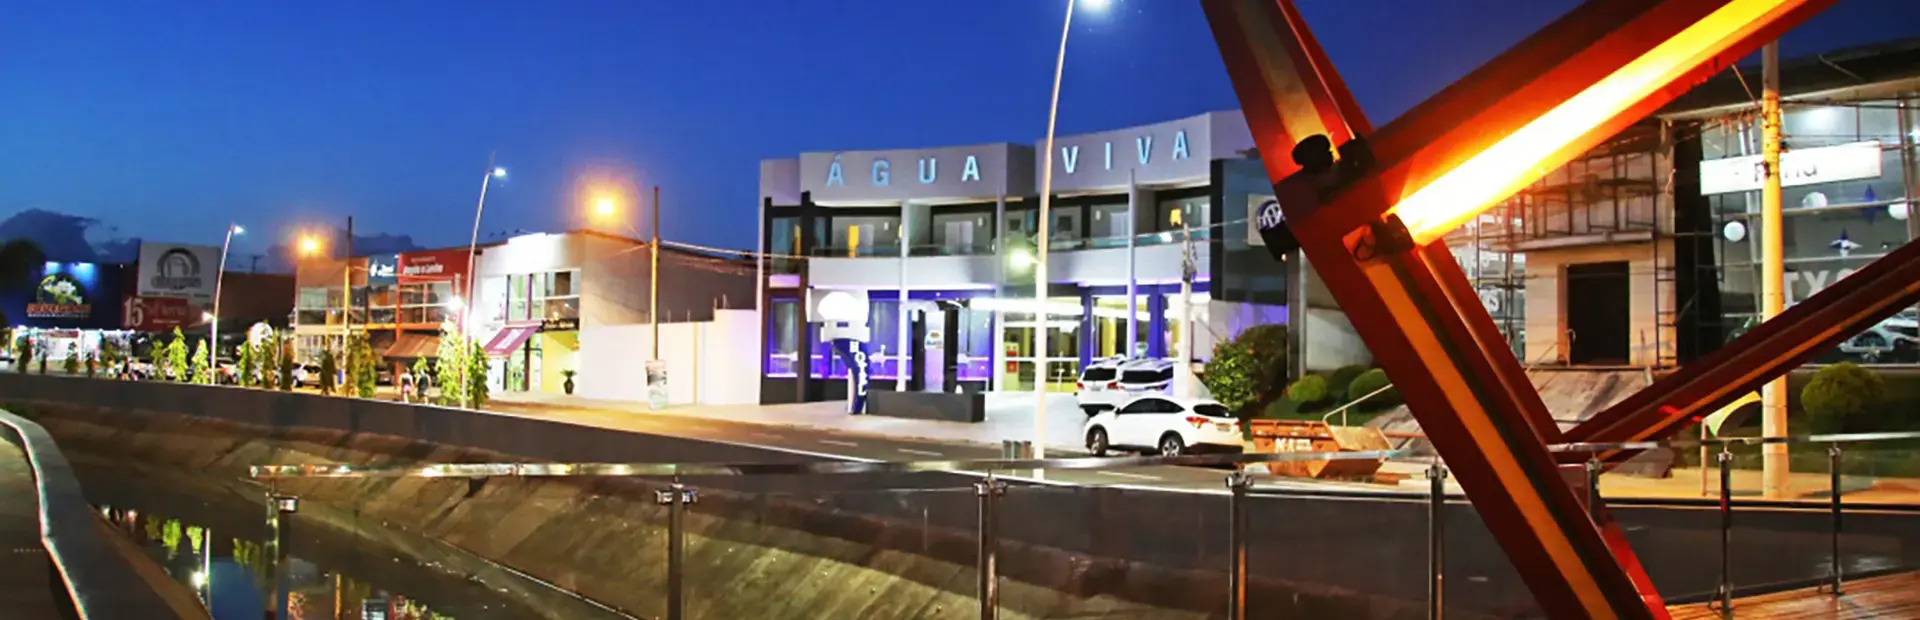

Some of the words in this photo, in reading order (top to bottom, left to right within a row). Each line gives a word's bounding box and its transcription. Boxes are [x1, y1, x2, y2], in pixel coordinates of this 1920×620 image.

[826, 153, 980, 187] ÁGUA
[1062, 130, 1189, 174] VIVA
[119, 297, 144, 328] 15
